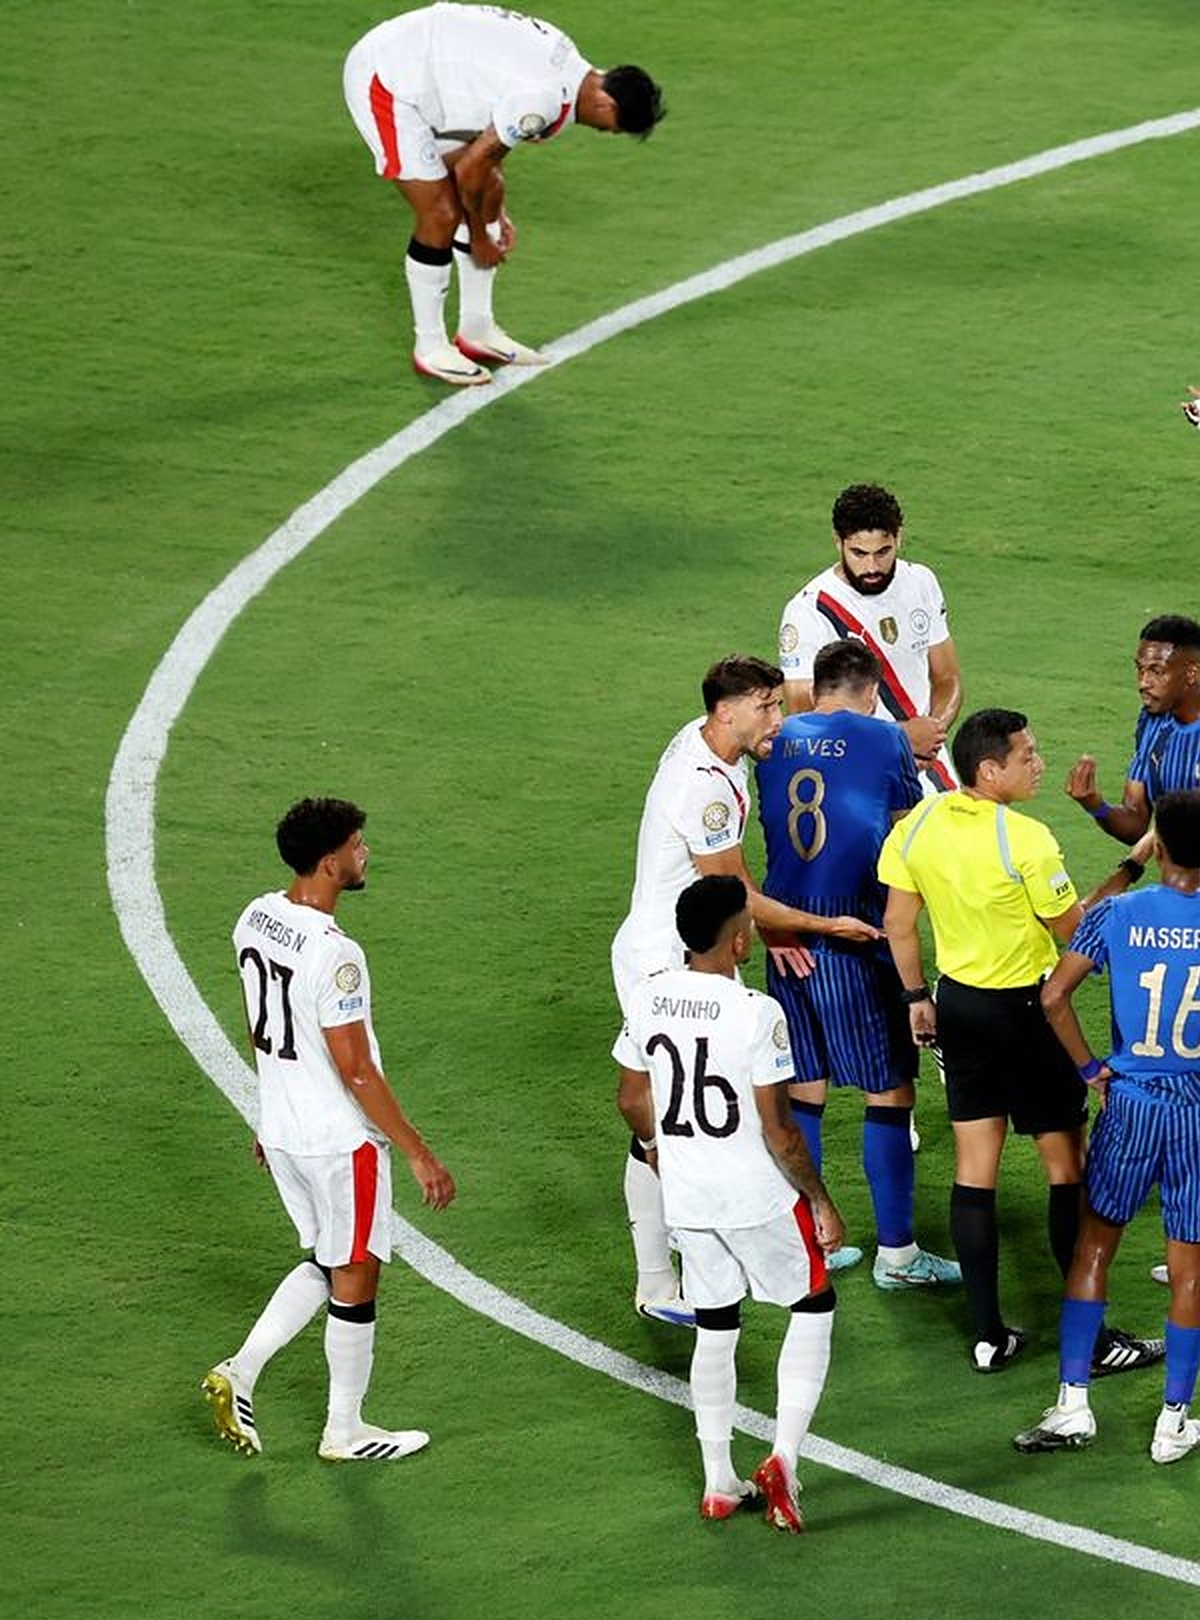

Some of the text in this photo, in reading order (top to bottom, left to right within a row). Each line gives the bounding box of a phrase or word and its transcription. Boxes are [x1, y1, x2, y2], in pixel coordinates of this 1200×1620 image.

[787, 768, 827, 862] 8
[239, 946, 298, 1061] 27
[651, 995, 721, 1021] SAVINHO
[645, 1032, 741, 1138] 26
